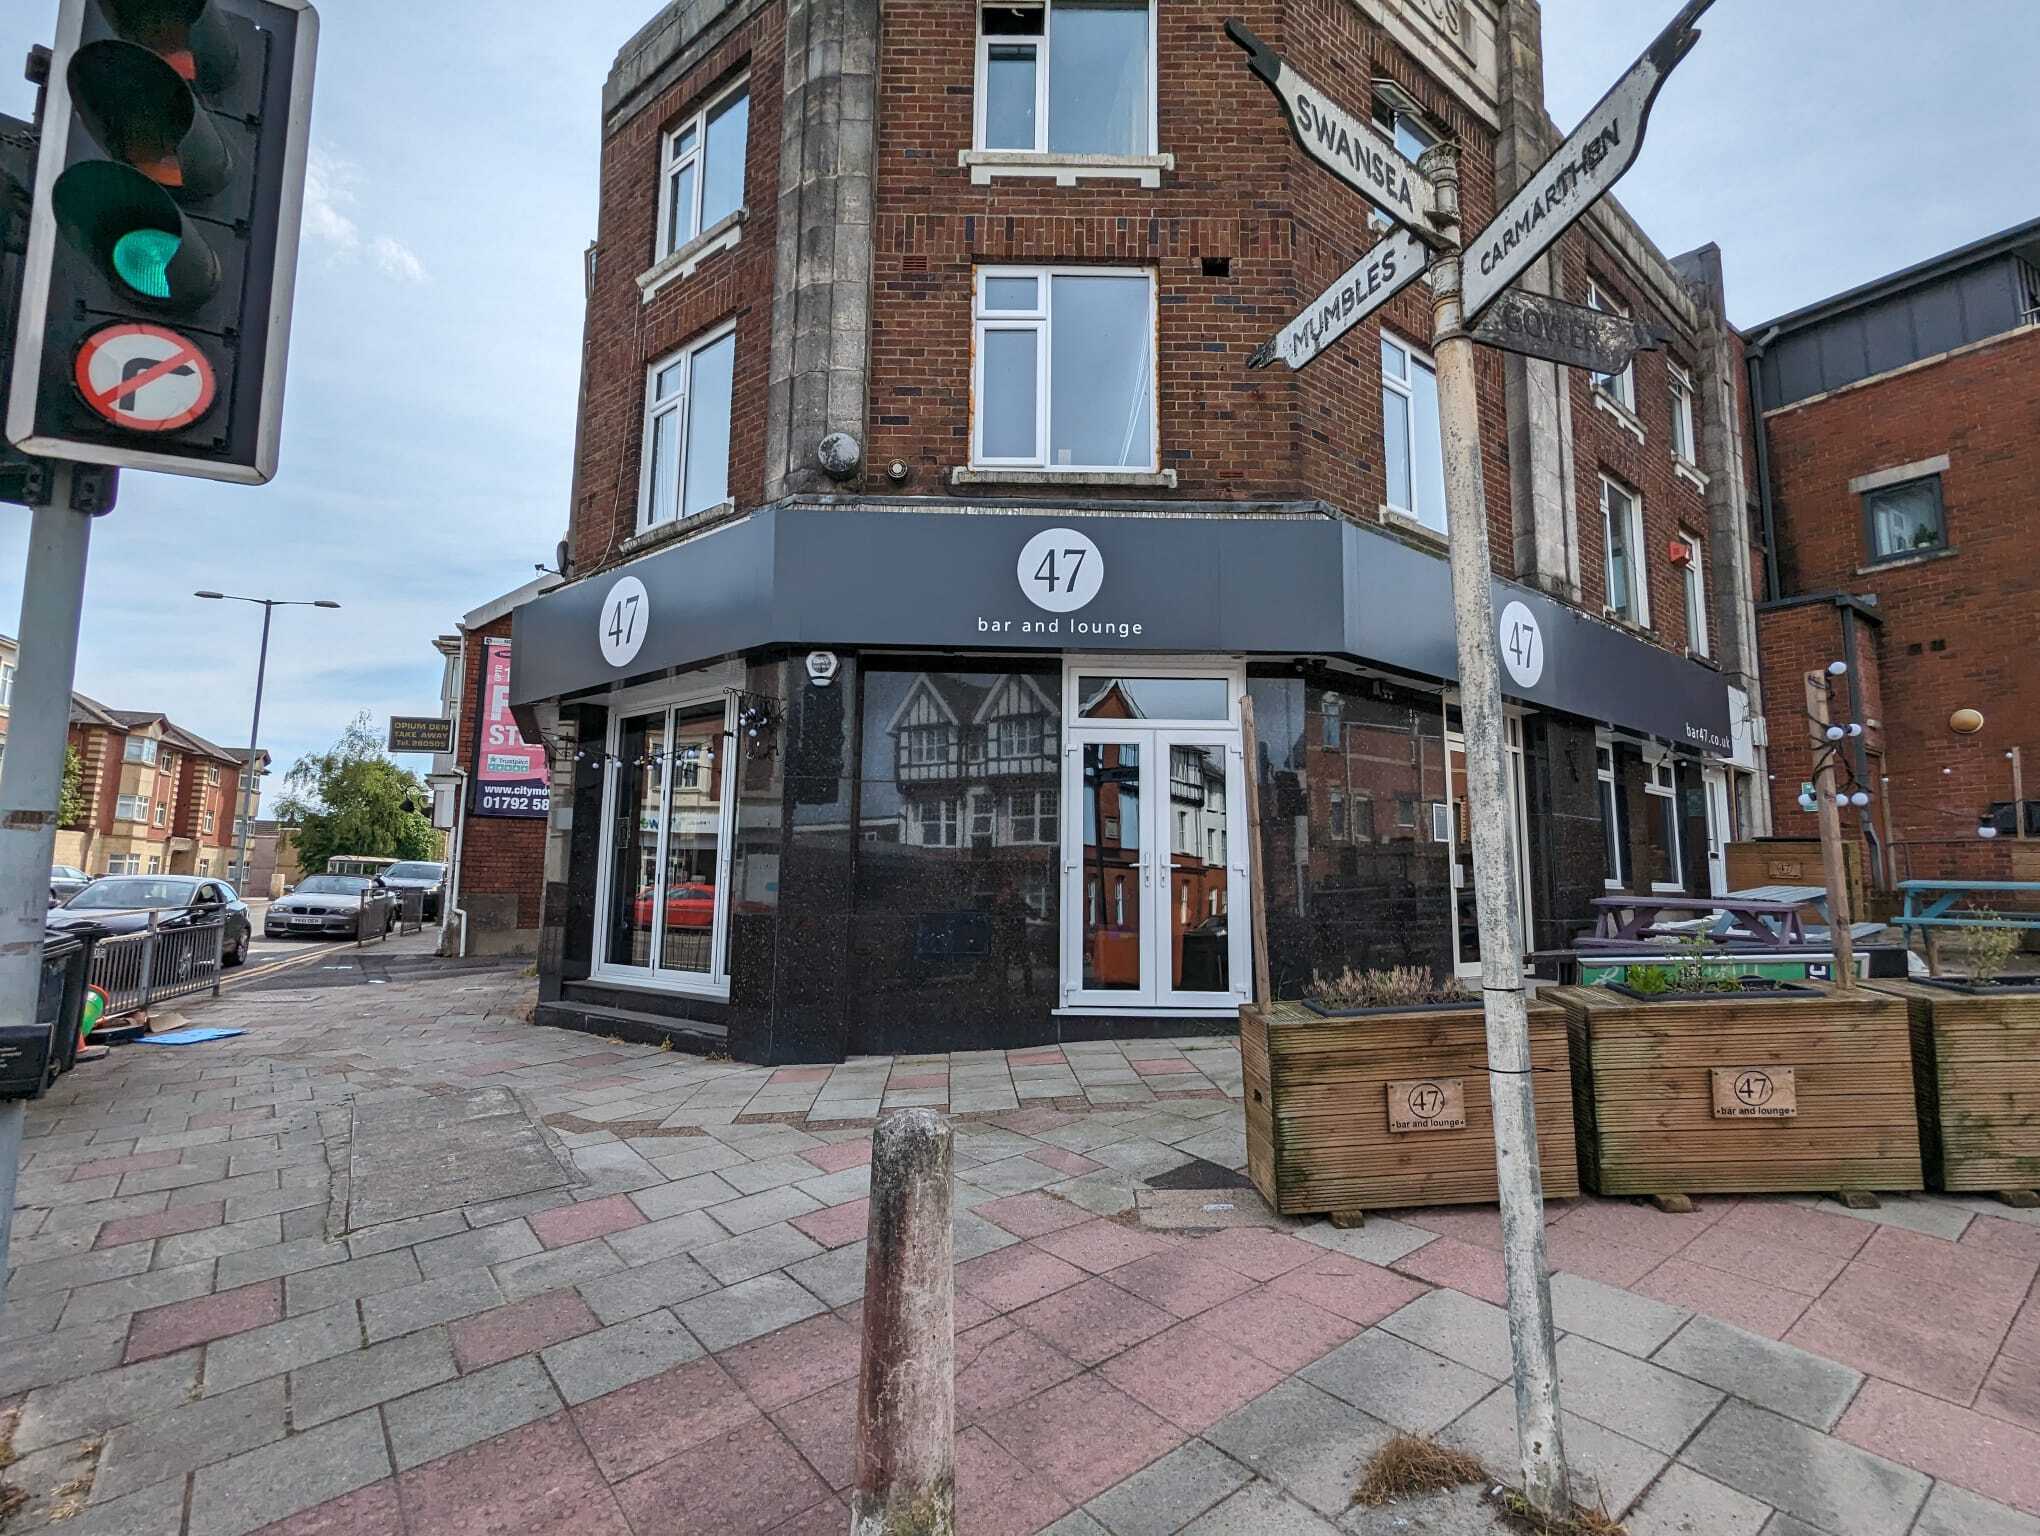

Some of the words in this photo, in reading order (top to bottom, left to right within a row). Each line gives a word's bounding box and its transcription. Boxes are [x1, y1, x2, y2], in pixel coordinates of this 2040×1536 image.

[1297, 94, 1414, 213] SWANSEA
[1480, 118, 1621, 276] CARMARTHEN
[1293, 248, 1397, 358] MUMBLES
[1503, 302, 1601, 352] GOWER
[1034, 549, 1087, 593] 47
[608, 594, 640, 648] 47
[977, 616, 1012, 632] bar
[1022, 618, 1060, 633] and
[1070, 618, 1144, 637] lounge
[1509, 621, 1534, 669] 47
[394, 721, 426, 730] OPIUM
[430, 723, 449, 731] DEN
[420, 731, 448, 739] AWAY
[1685, 721, 1730, 750] bar47.co.uk
[483, 796, 529, 810] 01792
[1413, 1090, 1439, 1111] 47
[1739, 1078, 1767, 1099] 47
[1395, 1120, 1410, 1129] bar
[1412, 1120, 1429, 1128] and
[1430, 1118, 1460, 1128] lounge
[1720, 1106, 1737, 1115] bar
[1739, 1106, 1756, 1115] and
[1758, 1106, 1790, 1117] lounge
